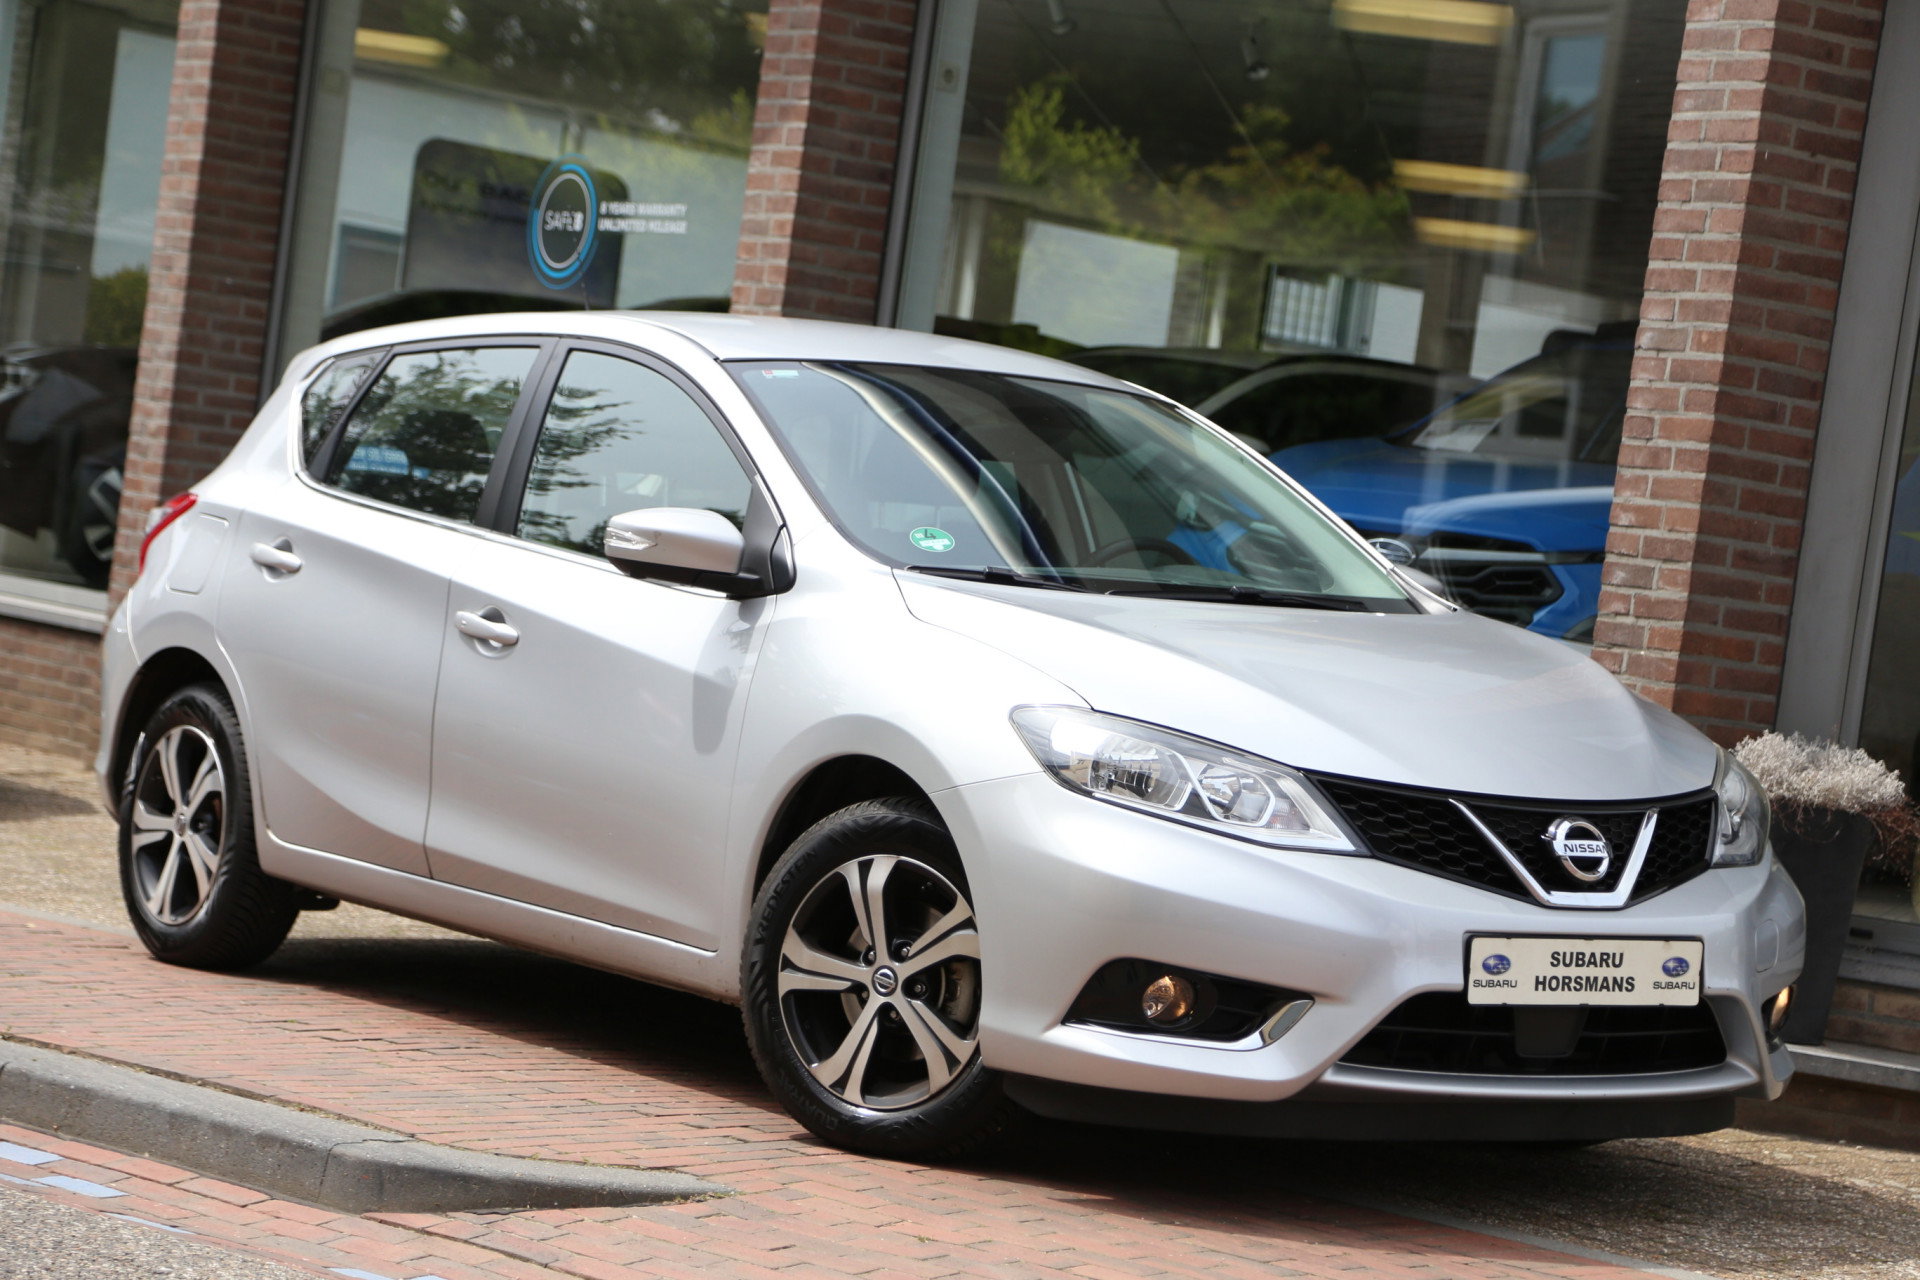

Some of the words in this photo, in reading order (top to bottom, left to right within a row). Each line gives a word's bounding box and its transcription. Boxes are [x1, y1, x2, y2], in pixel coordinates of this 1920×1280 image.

[1550, 951, 1624, 968] SUBARU
[1472, 979, 1518, 989] SUBARU
[1534, 975, 1636, 993] HORSMANS
[1652, 980, 1696, 991] SUBARU
